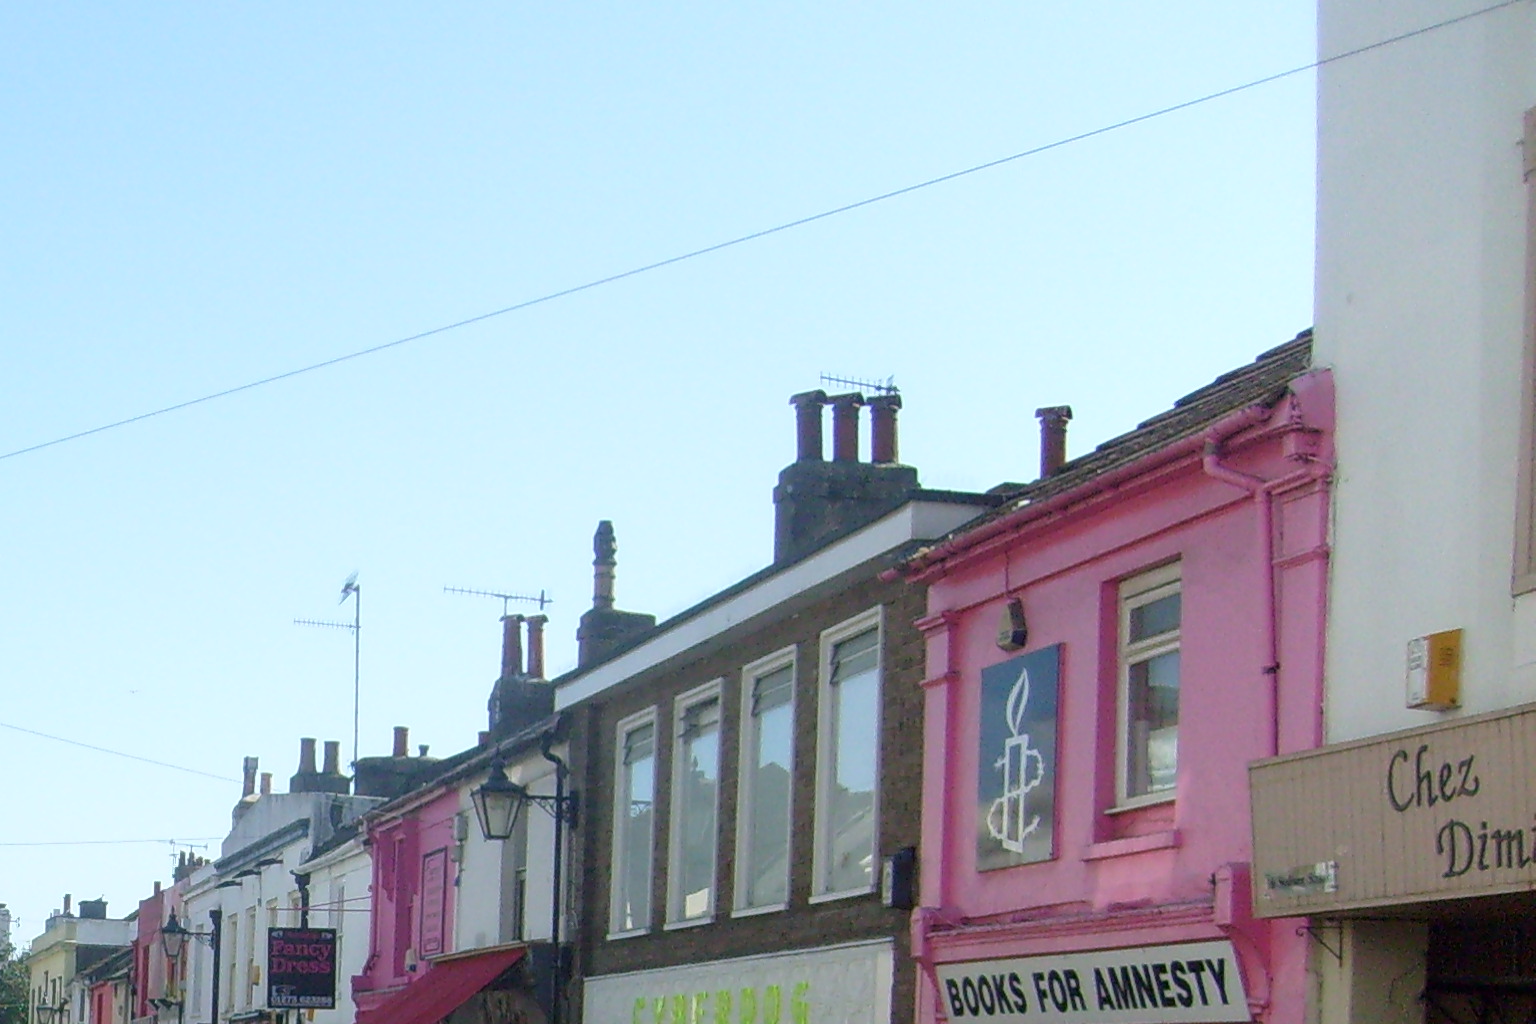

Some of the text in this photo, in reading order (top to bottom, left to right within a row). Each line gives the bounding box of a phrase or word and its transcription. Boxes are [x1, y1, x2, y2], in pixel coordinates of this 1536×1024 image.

[1387, 744, 1480, 812] Chez
[270, 940, 332, 961] Fancy
[270, 958, 332, 974] Dress
[945, 957, 1230, 1017] BOOKS FOR AMNESTY
